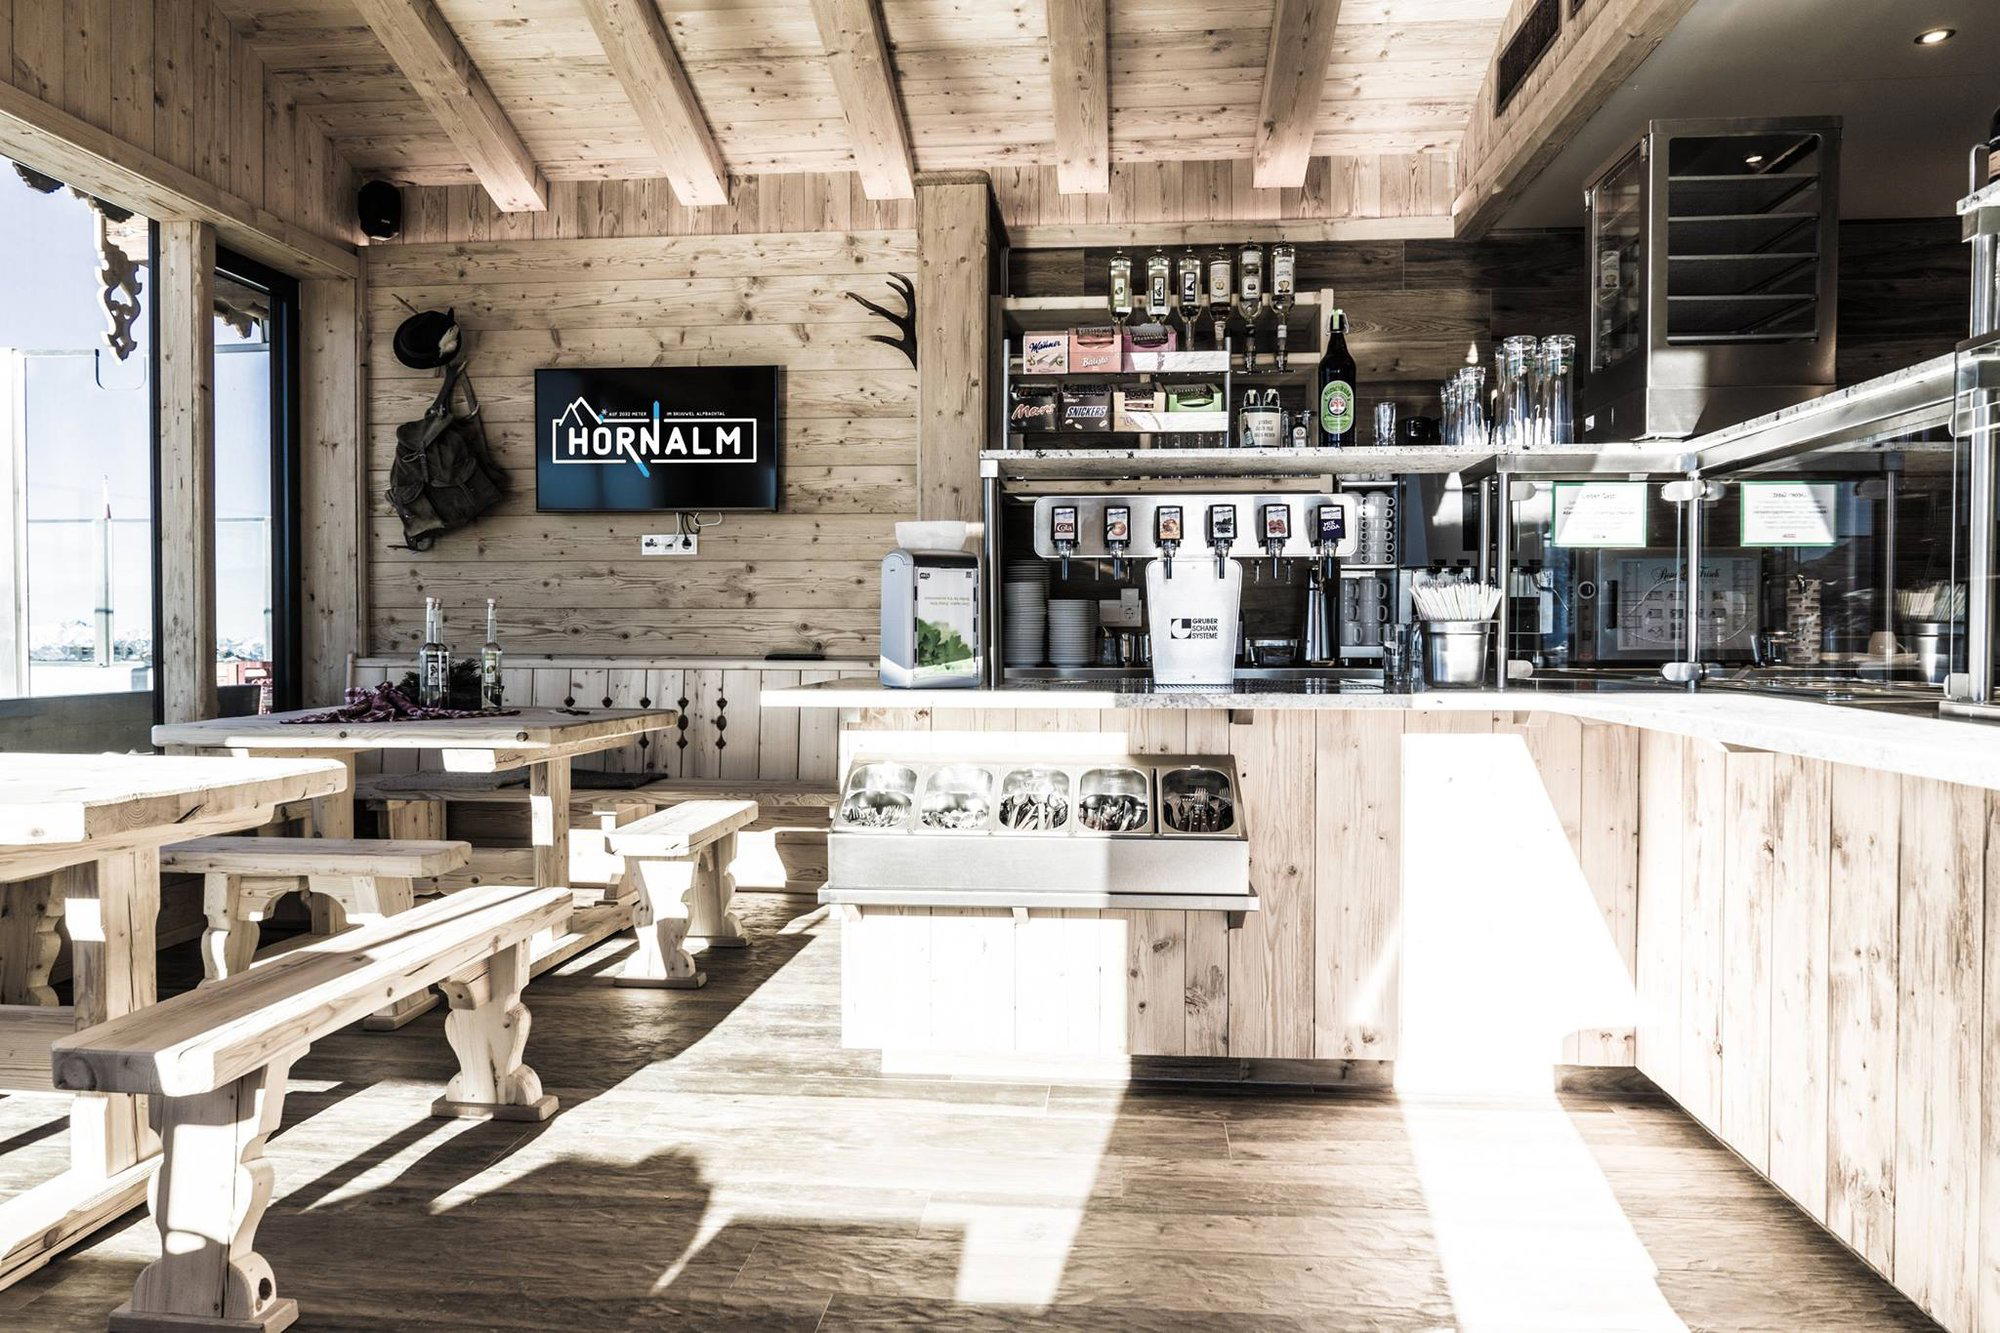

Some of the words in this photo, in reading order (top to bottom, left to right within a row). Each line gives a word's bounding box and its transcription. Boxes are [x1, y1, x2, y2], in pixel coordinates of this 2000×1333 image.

[1029, 340, 1061, 353] Manner
[1012, 403, 1056, 420] Mars
[1067, 406, 1107, 417] SNICKERS
[568, 426, 741, 456] HORNALM
[1056, 523, 1072, 533] Cola
[1323, 524, 1340, 532] SODA
